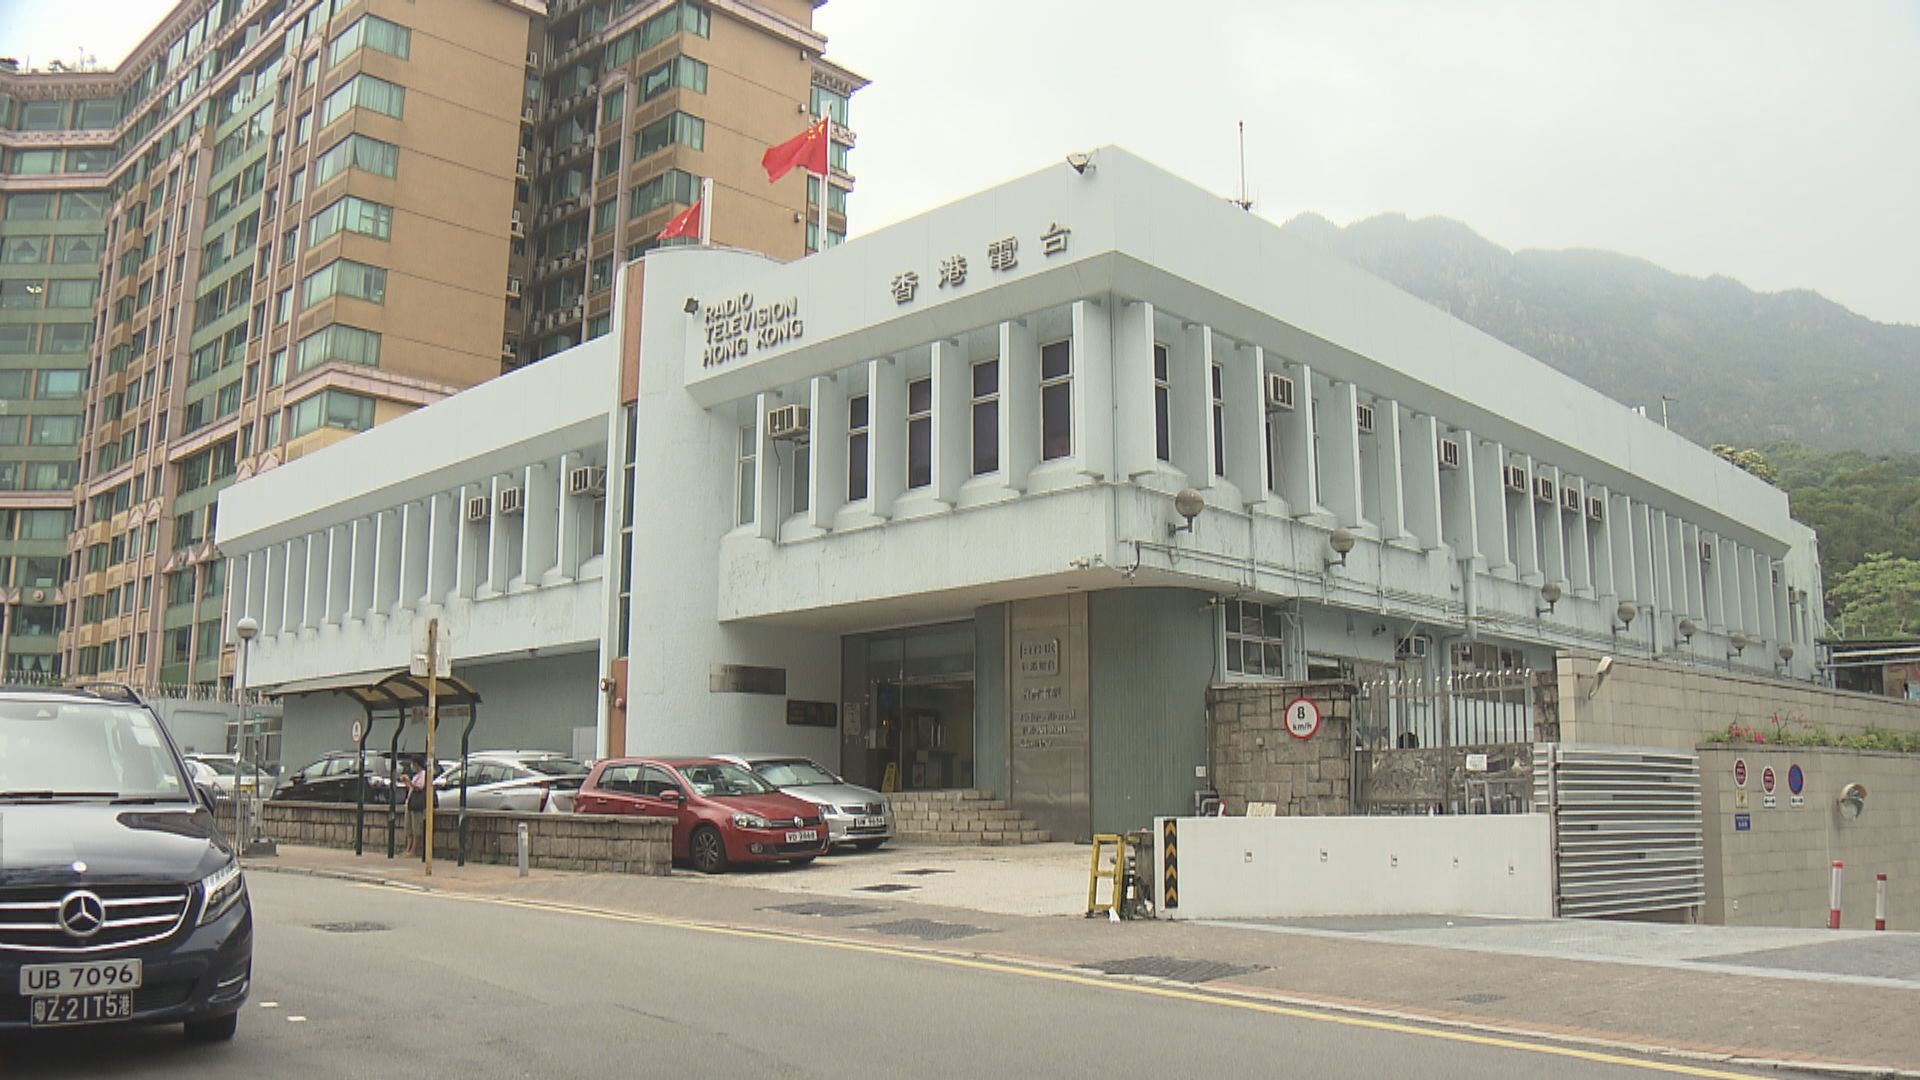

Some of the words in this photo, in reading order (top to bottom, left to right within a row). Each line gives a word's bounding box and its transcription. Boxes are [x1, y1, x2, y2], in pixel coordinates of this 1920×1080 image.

[891, 222, 1072, 305] 香港電台
[704, 292, 753, 324] RADIO
[704, 296, 798, 345] TELEVISION
[702, 337, 749, 369] HONG
[755, 319, 804, 351] KONG
[1297, 706, 1305, 719] 8
[28, 970, 61, 989] UB
[70, 965, 133, 988] 7096
